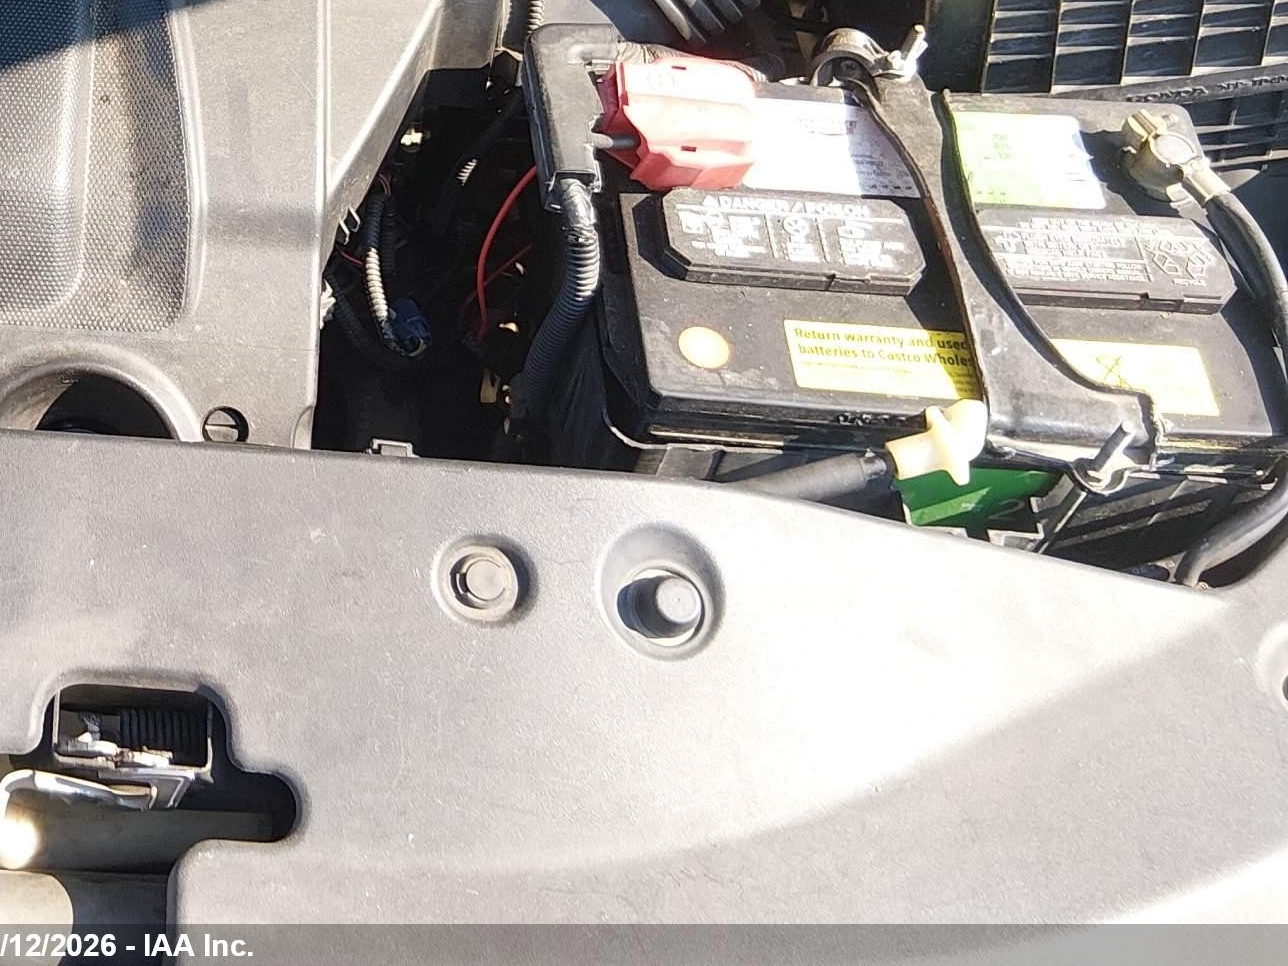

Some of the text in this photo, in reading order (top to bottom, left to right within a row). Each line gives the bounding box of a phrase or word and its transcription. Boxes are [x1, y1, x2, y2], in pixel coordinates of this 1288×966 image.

[794, 328, 841, 341] Return
[844, 331, 905, 349] warranty
[906, 335, 934, 348] and
[798, 343, 858, 359] batteries
[861, 346, 875, 359] to
[878, 348, 921, 364] Costco
